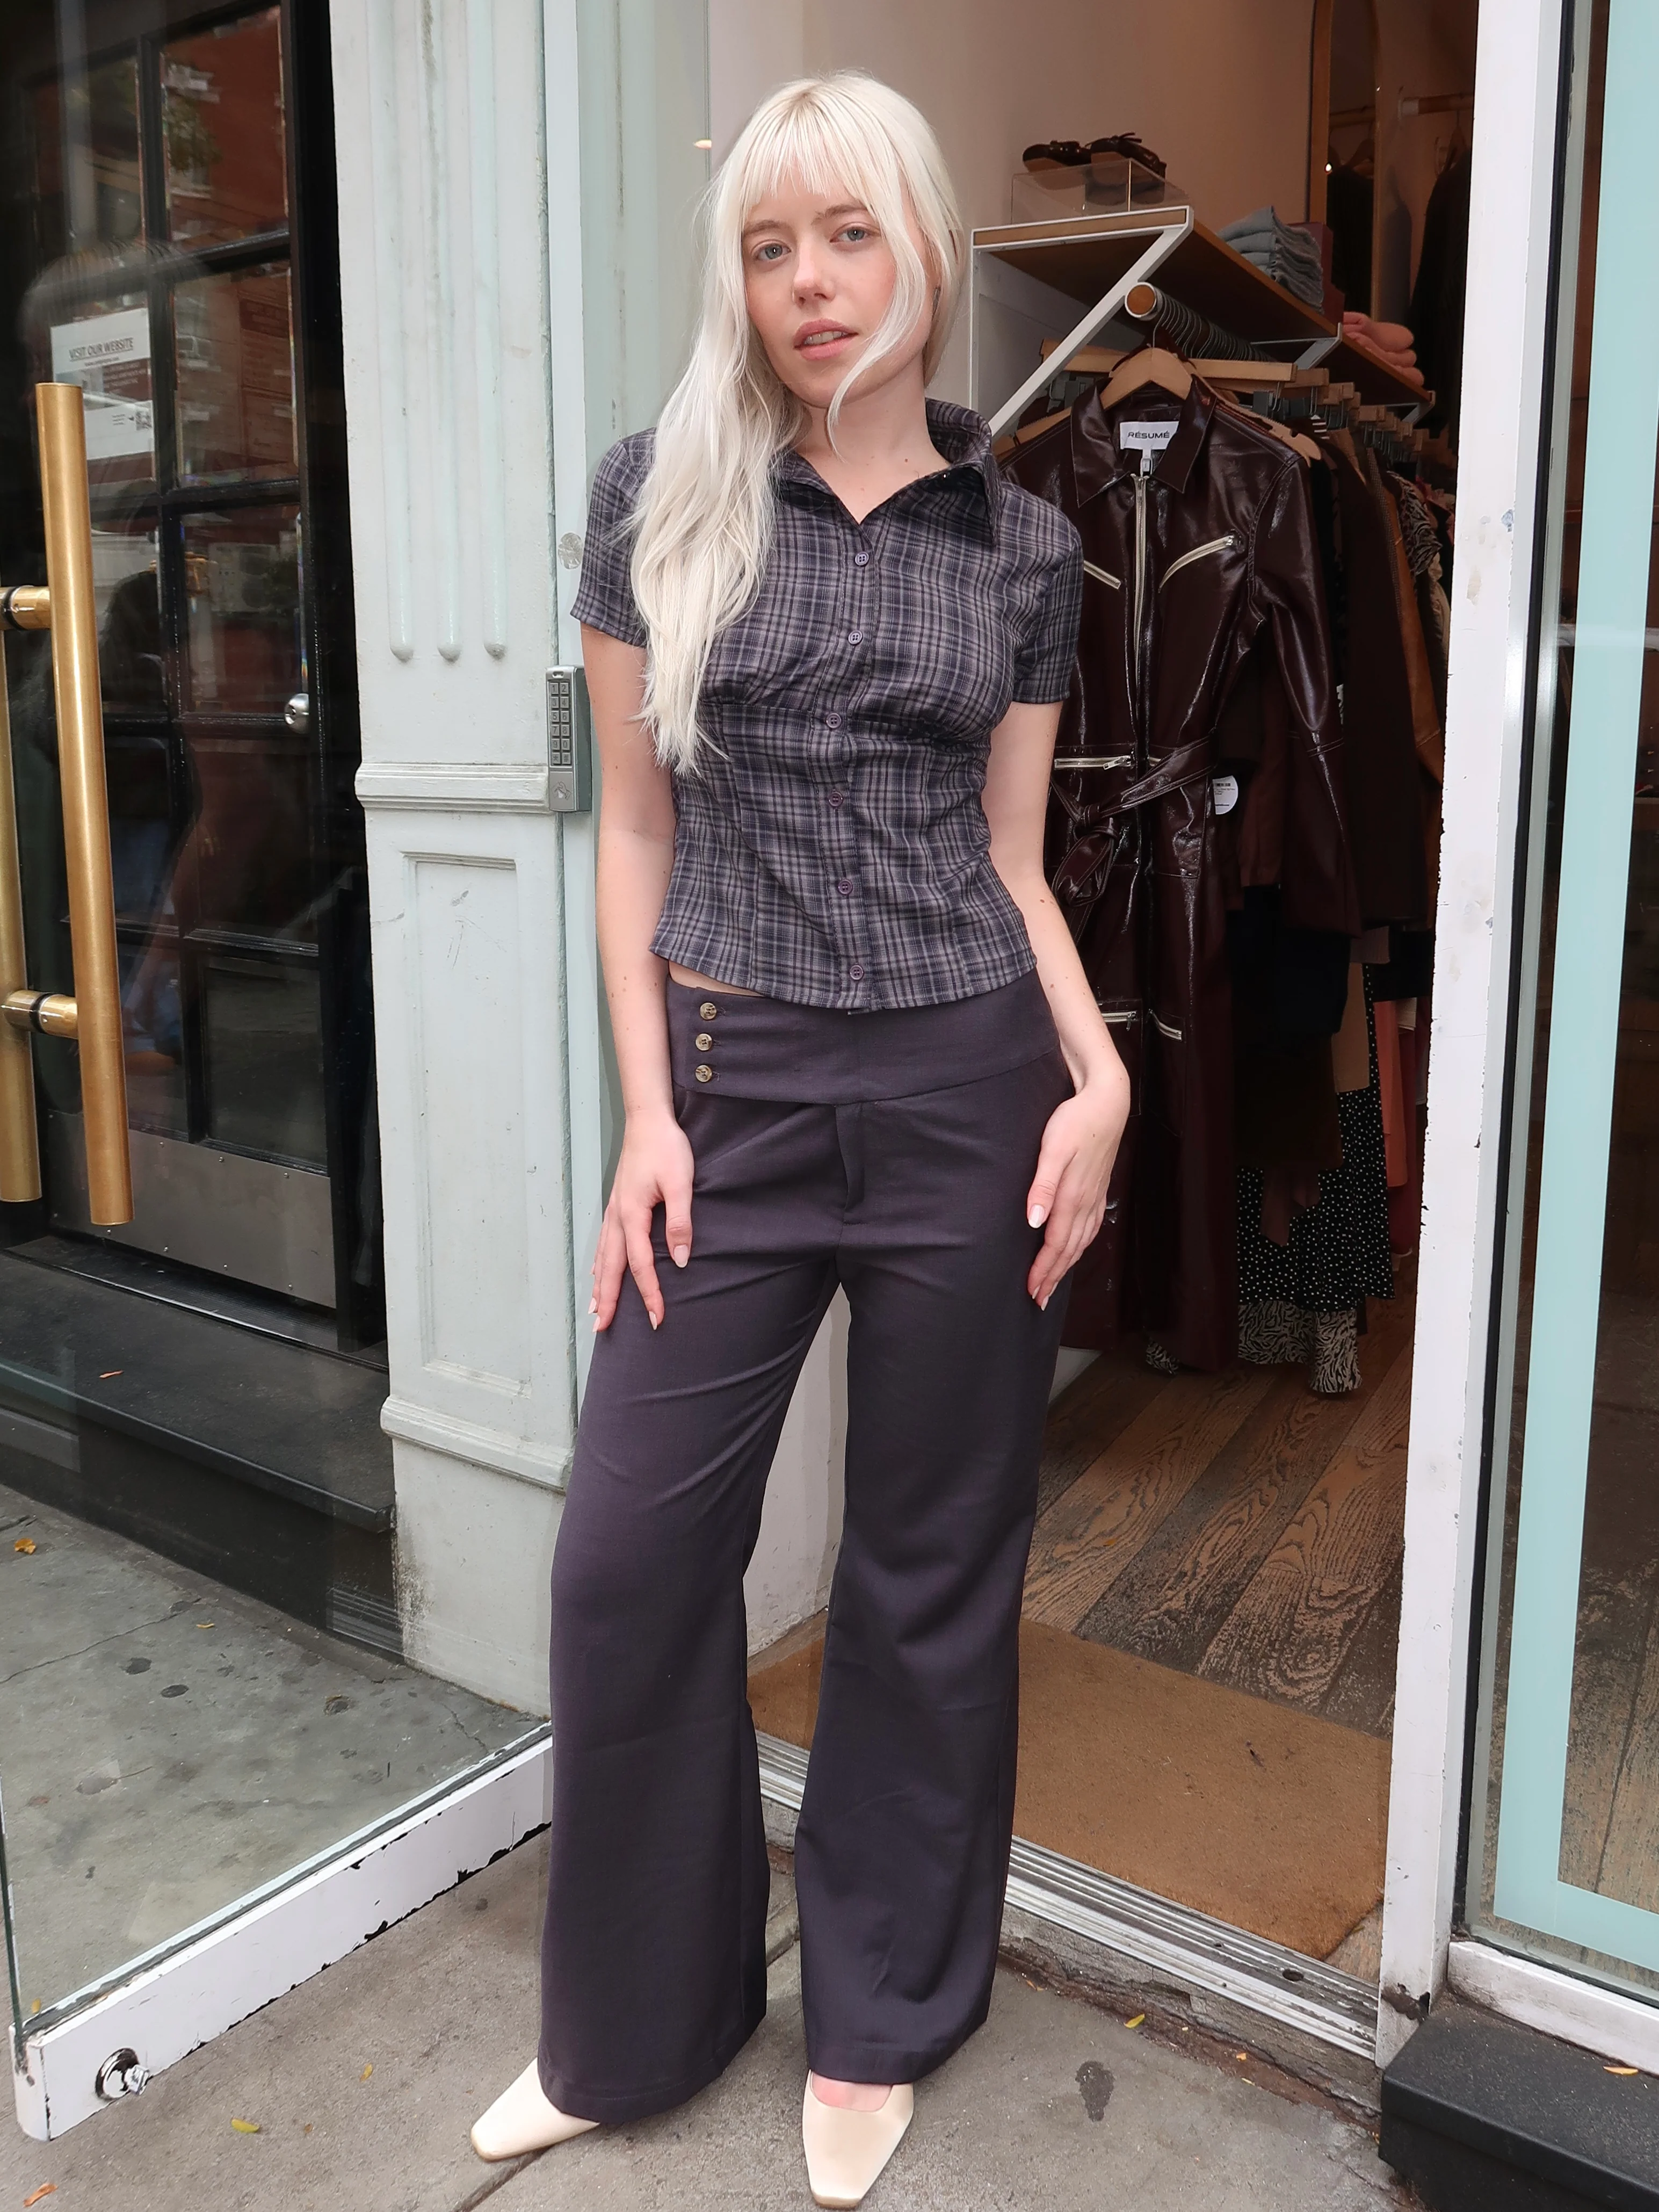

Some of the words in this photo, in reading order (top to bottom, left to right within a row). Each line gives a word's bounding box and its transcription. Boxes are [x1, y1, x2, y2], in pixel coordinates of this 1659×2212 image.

[68, 346, 86, 359] VISIT
[87, 343, 103, 355] OUR
[103, 337, 134, 352] WEBSITE
[1128, 431, 1170, 439] RÉSUMÉ
[561, 684, 566, 692] 2
[553, 712, 557, 720] 5
[562, 712, 567, 720] 6
[562, 726, 567, 734] 8
